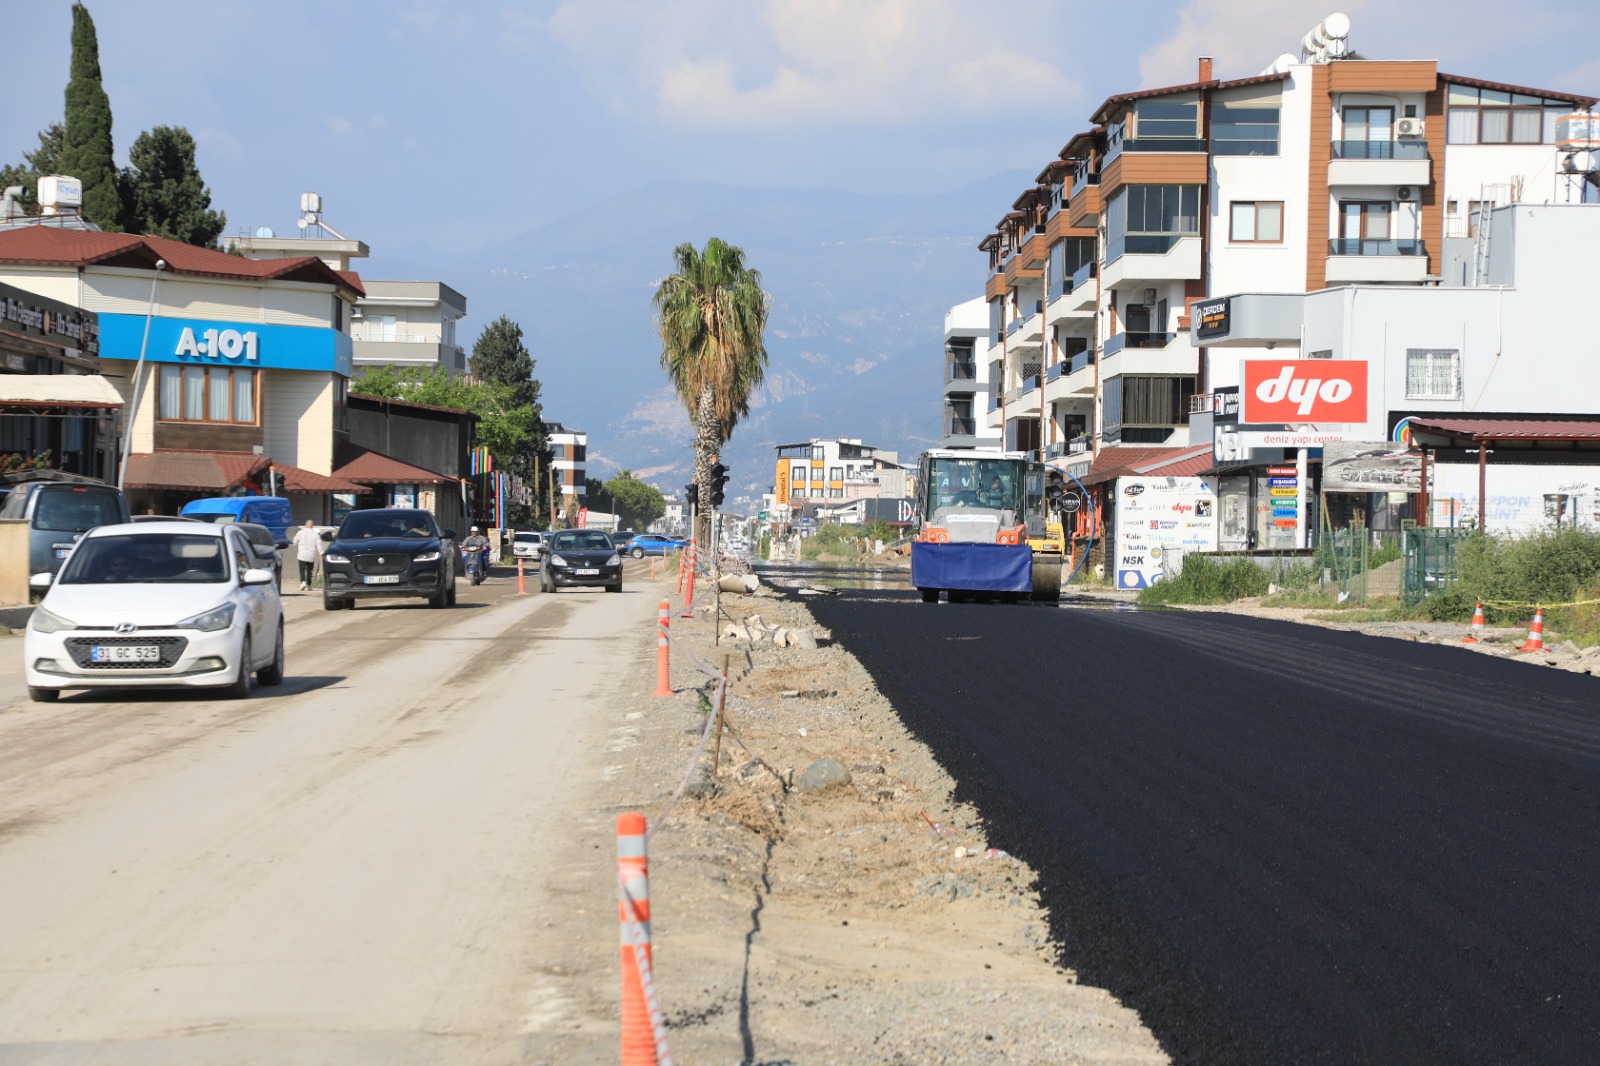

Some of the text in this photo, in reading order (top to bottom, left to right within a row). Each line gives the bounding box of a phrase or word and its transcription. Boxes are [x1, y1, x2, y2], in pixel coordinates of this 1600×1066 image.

[1255, 366, 1353, 415] dyo
[1263, 435, 1290, 444] deniz
[1172, 503, 1192, 513] dyo
[1122, 556, 1145, 565] NSK
[98, 648, 111, 658] 31
[136, 648, 158, 658] 525
